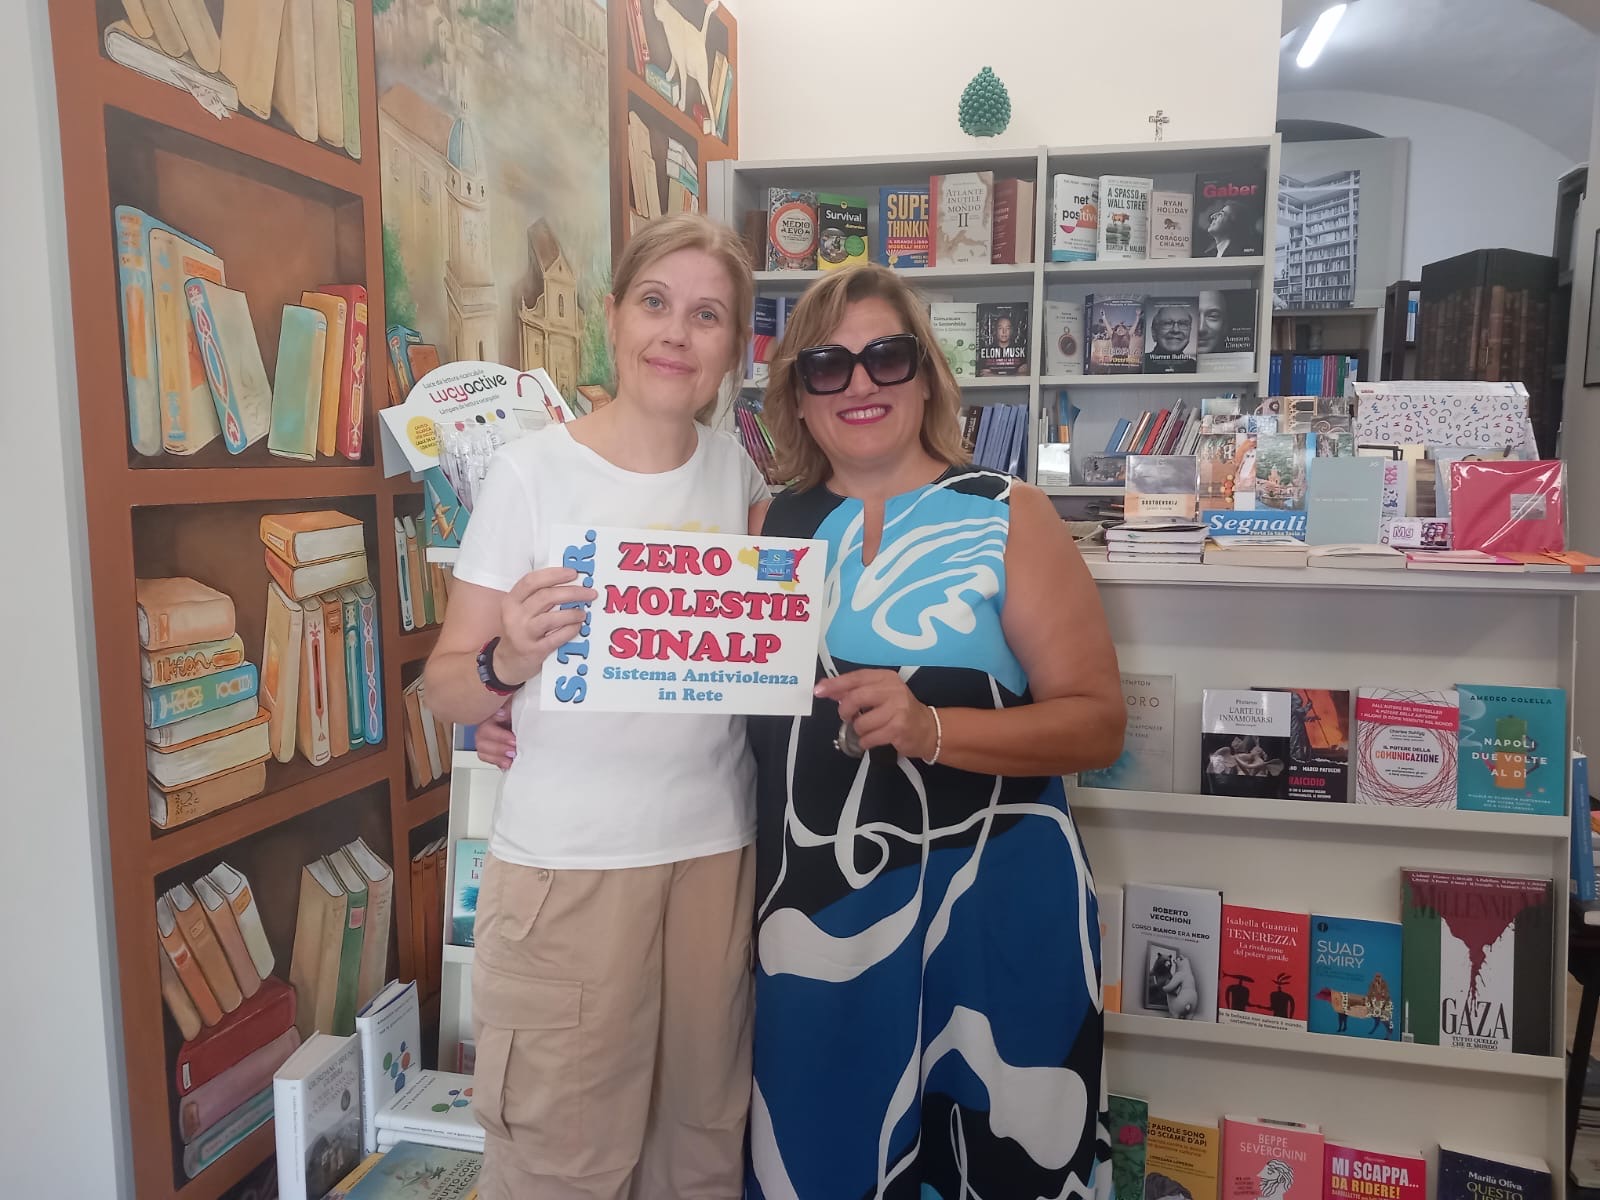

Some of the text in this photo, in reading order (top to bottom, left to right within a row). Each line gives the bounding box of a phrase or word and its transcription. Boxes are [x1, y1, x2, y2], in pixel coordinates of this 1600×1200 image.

[946, 188, 985, 198] ATLANTE
[1107, 187, 1113, 198] A
[1114, 187, 1139, 200] SPASSO
[1203, 182, 1257, 199] Gaber
[947, 195, 981, 204] INUTILE
[1074, 194, 1090, 205] net
[1107, 198, 1124, 209] WALL
[825, 209, 862, 223] Survival
[947, 204, 982, 214] MONDO
[782, 220, 811, 229] MEDIO
[958, 212, 969, 228] II
[1154, 234, 1190, 242] CORAGGIO
[1159, 240, 1185, 248] CHIAMA
[981, 346, 1026, 359] ELON MUSK
[1149, 353, 1171, 361] Warren
[1208, 513, 1307, 535] Segnali
[617, 541, 733, 577] ZERO
[602, 584, 811, 622] MOLESTIE
[554, 529, 598, 705] S.T..R.
[608, 627, 782, 664] SINALP
[602, 665, 799, 686] Sistema Antiviolenza
[658, 687, 724, 702] in Rete
[1470, 695, 1508, 703] AMEDEO
[1229, 706, 1265, 716] L'ARTE DI
[1219, 714, 1273, 724] INNAMORARSI
[1483, 737, 1535, 749] NAPOLI
[1375, 750, 1440, 764] COMUNICAZIONE
[1471, 752, 1549, 765] DUE VOLTE
[1490, 768, 1508, 777] AL
[1152, 906, 1189, 917] ROBERTO
[1149, 913, 1192, 925] VECCHIONI
[1226, 916, 1299, 933] Isabella Guanzini
[1152, 926, 1177, 935] BIANCO
[1177, 930, 1191, 938] ERA
[1226, 927, 1297, 947] TENEREZZA
[1239, 941, 1284, 954] La rivoluzione
[1316, 939, 1365, 957] SUAD
[1244, 950, 1266, 959] potere
[1266, 953, 1289, 962] gentile
[1315, 952, 1365, 969] AMIRY
[1442, 997, 1510, 1039] GAZA
[1473, 1037, 1499, 1045] QUELLO
[1151, 1123, 1206, 1139] PAROLE SONO
[1157, 1131, 1207, 1147] SCIAME D'API
[1258, 1133, 1288, 1148] BEPPE
[1240, 1141, 1307, 1161] SEVERGNINI
[458, 1158, 478, 1177] COME
[1331, 1157, 1419, 1188] MI SCAPPA...
[453, 1164, 482, 1194] PECCATO
[1498, 1178, 1522, 1191] Oliva
[1331, 1175, 1401, 1200] DA RIDERE!
[1466, 1181, 1523, 1200] QUESTO
